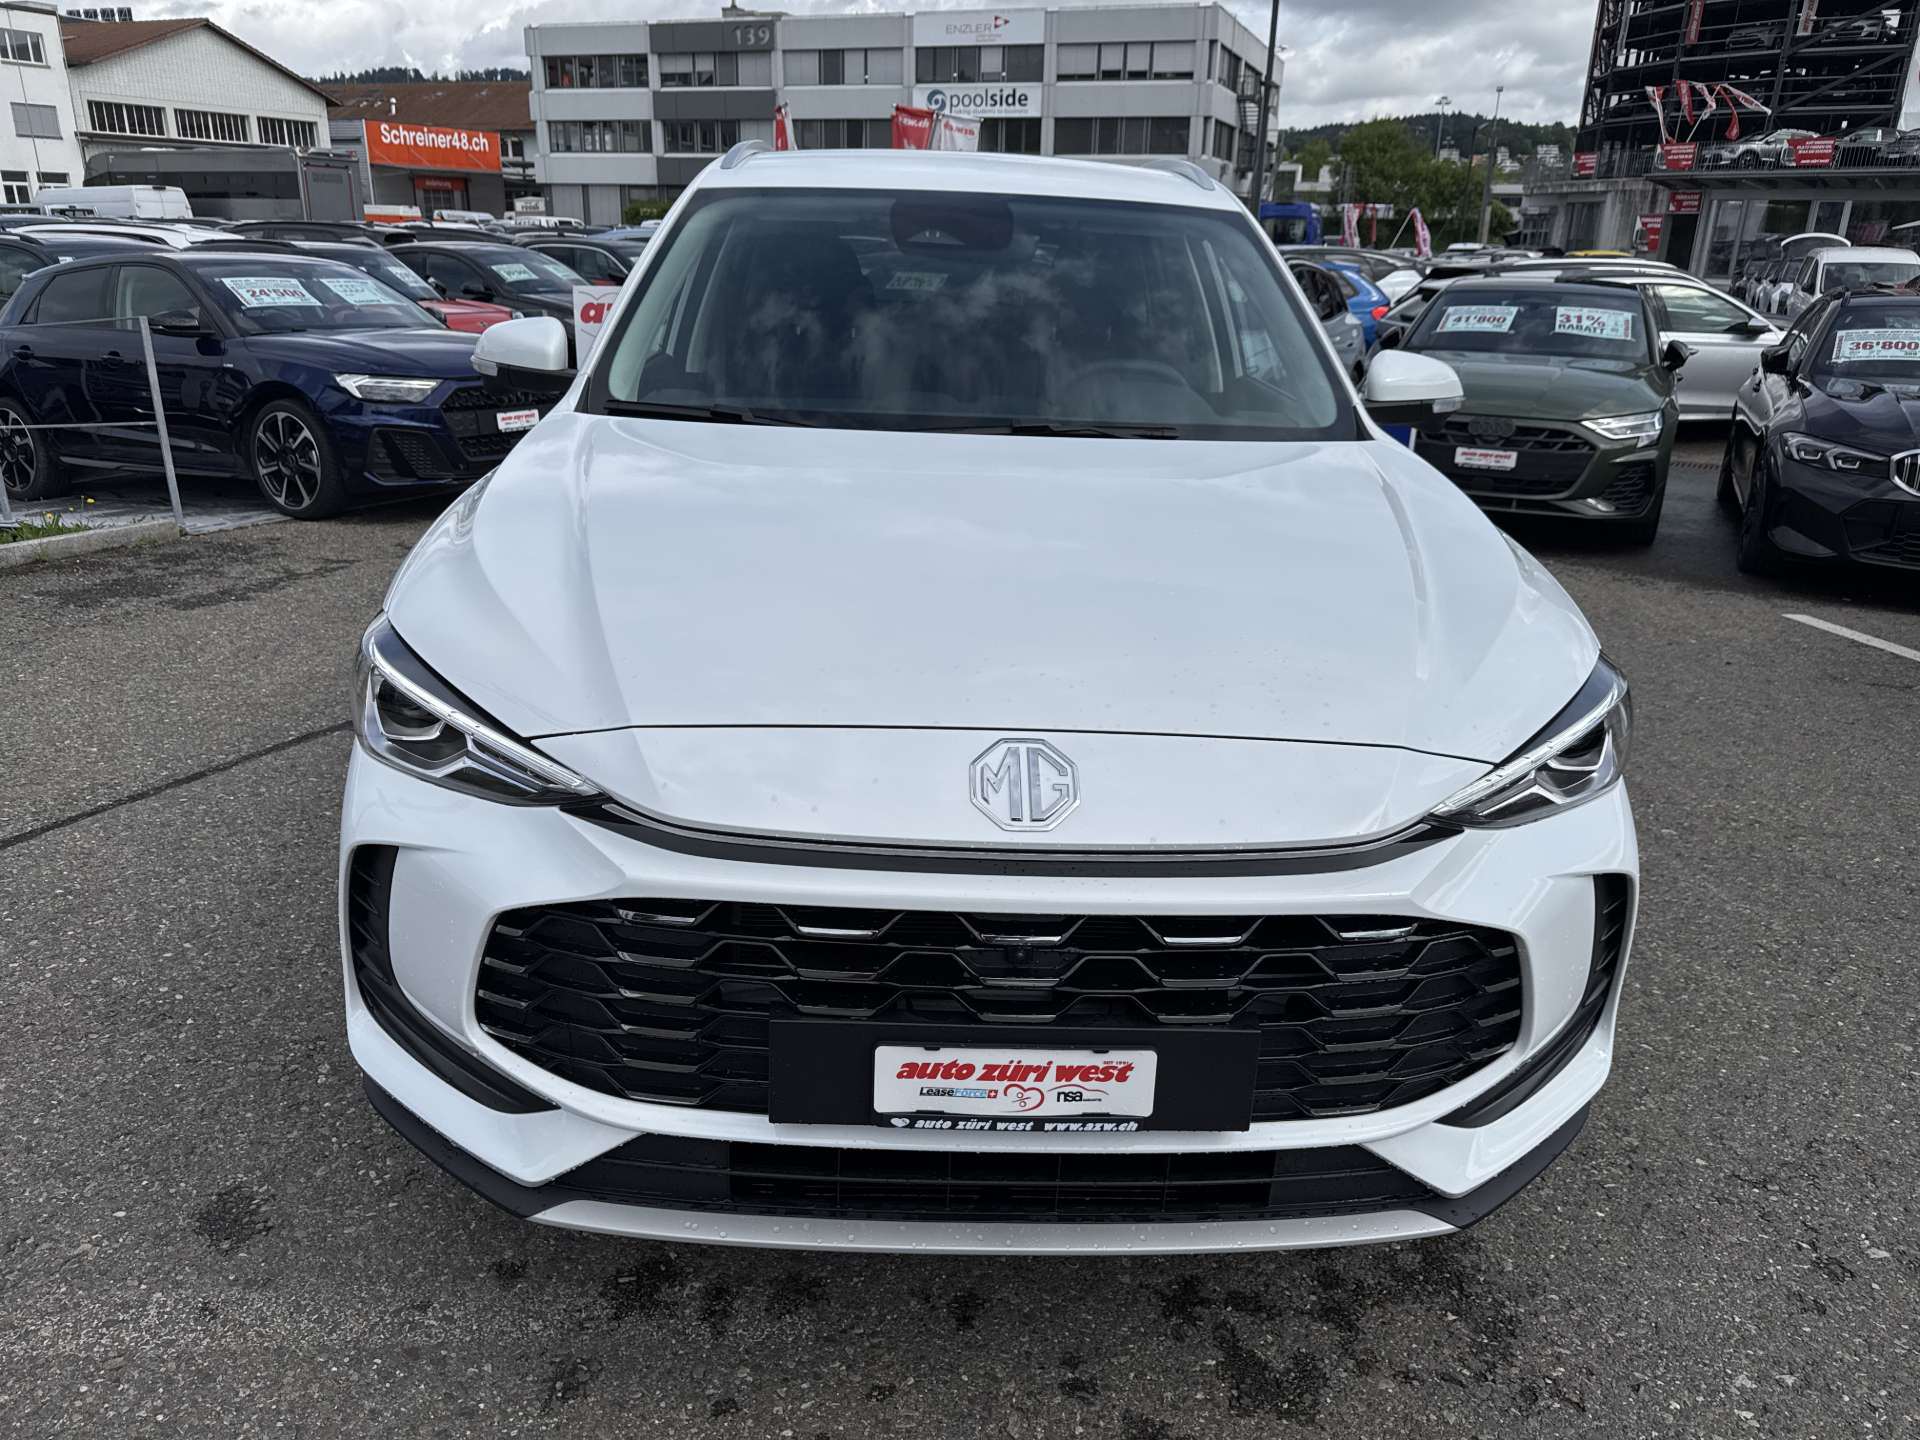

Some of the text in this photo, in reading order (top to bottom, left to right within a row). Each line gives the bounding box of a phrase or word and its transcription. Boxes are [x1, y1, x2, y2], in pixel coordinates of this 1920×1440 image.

[731, 25, 770, 45] 139
[945, 23, 993, 35] ENZLER
[950, 87, 1029, 114] poolside
[380, 123, 489, 152] Schreiner48.ch
[1559, 313, 1606, 328] 31%
[1558, 324, 1606, 335] RABATT
[1849, 341, 1920, 351] 36'800
[981, 746, 1070, 822] MG
[896, 1059, 1135, 1083] auto züri west
[919, 1087, 988, 1099] LeaseForce
[1056, 1091, 1083, 1102] nsa
[914, 1118, 1139, 1132] auto züri west www.azw.ch
